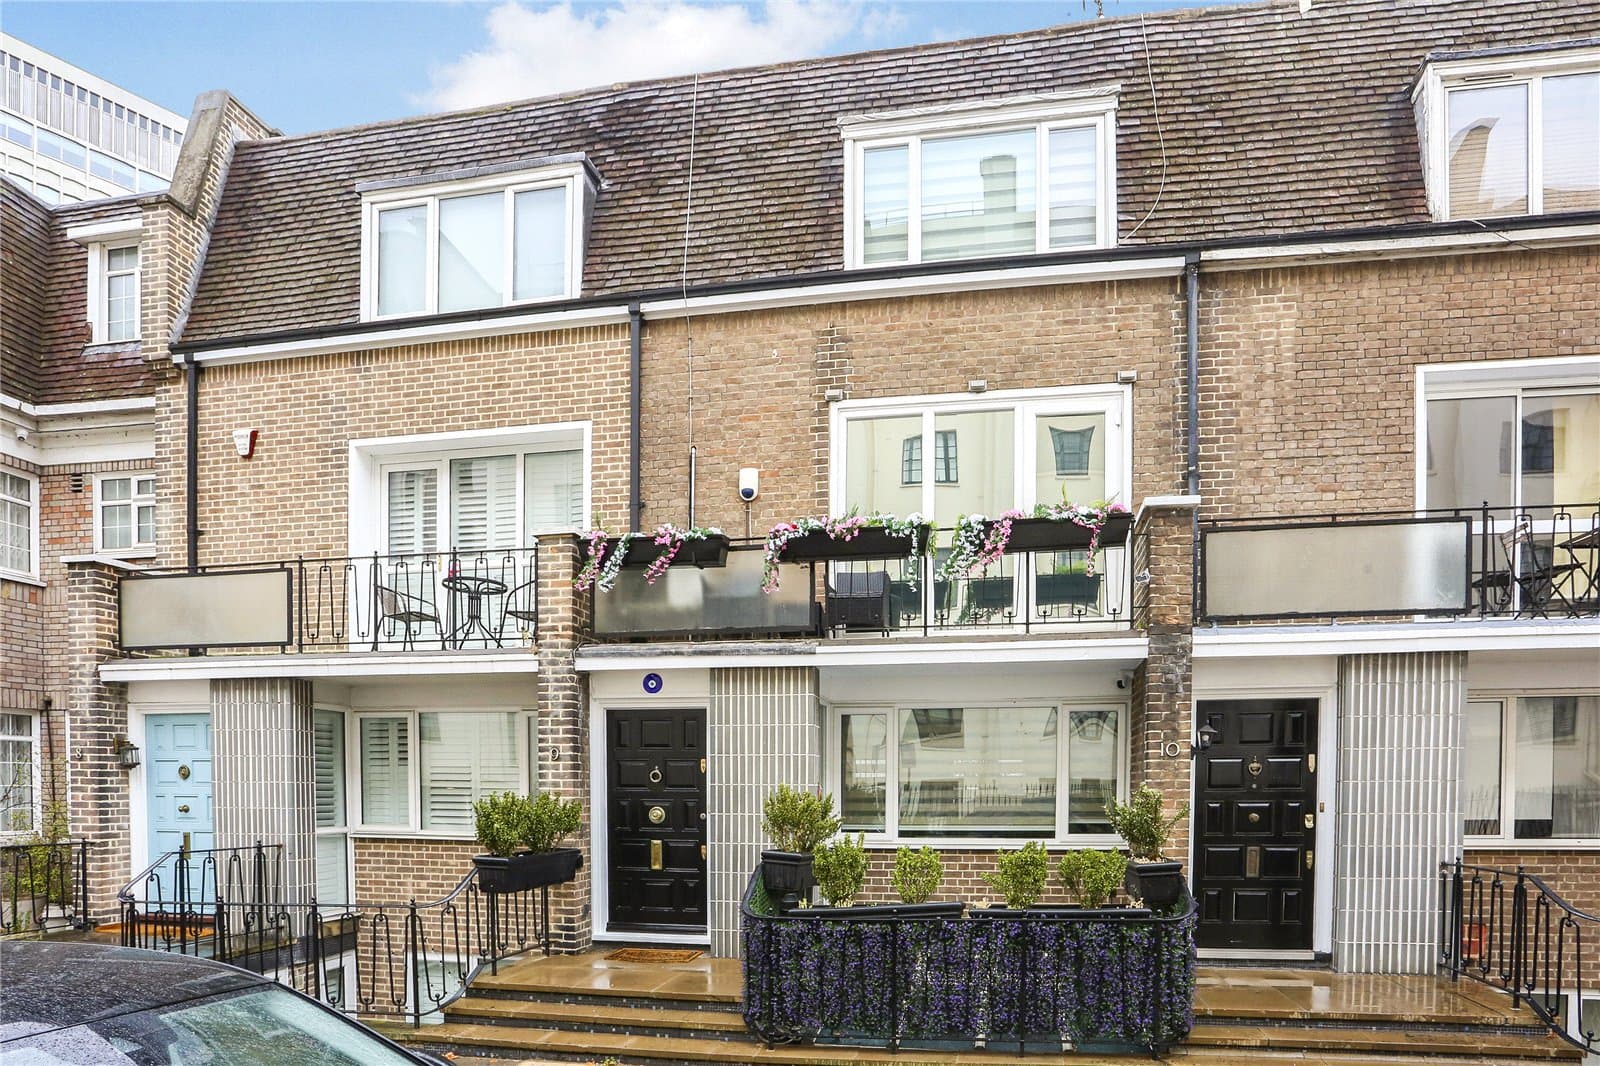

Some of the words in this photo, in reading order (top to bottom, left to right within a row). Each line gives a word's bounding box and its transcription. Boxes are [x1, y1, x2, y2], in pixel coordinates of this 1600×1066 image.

[75, 747, 82, 759] 8
[550, 747, 559, 761] 9
[1160, 742, 1180, 757] 10
